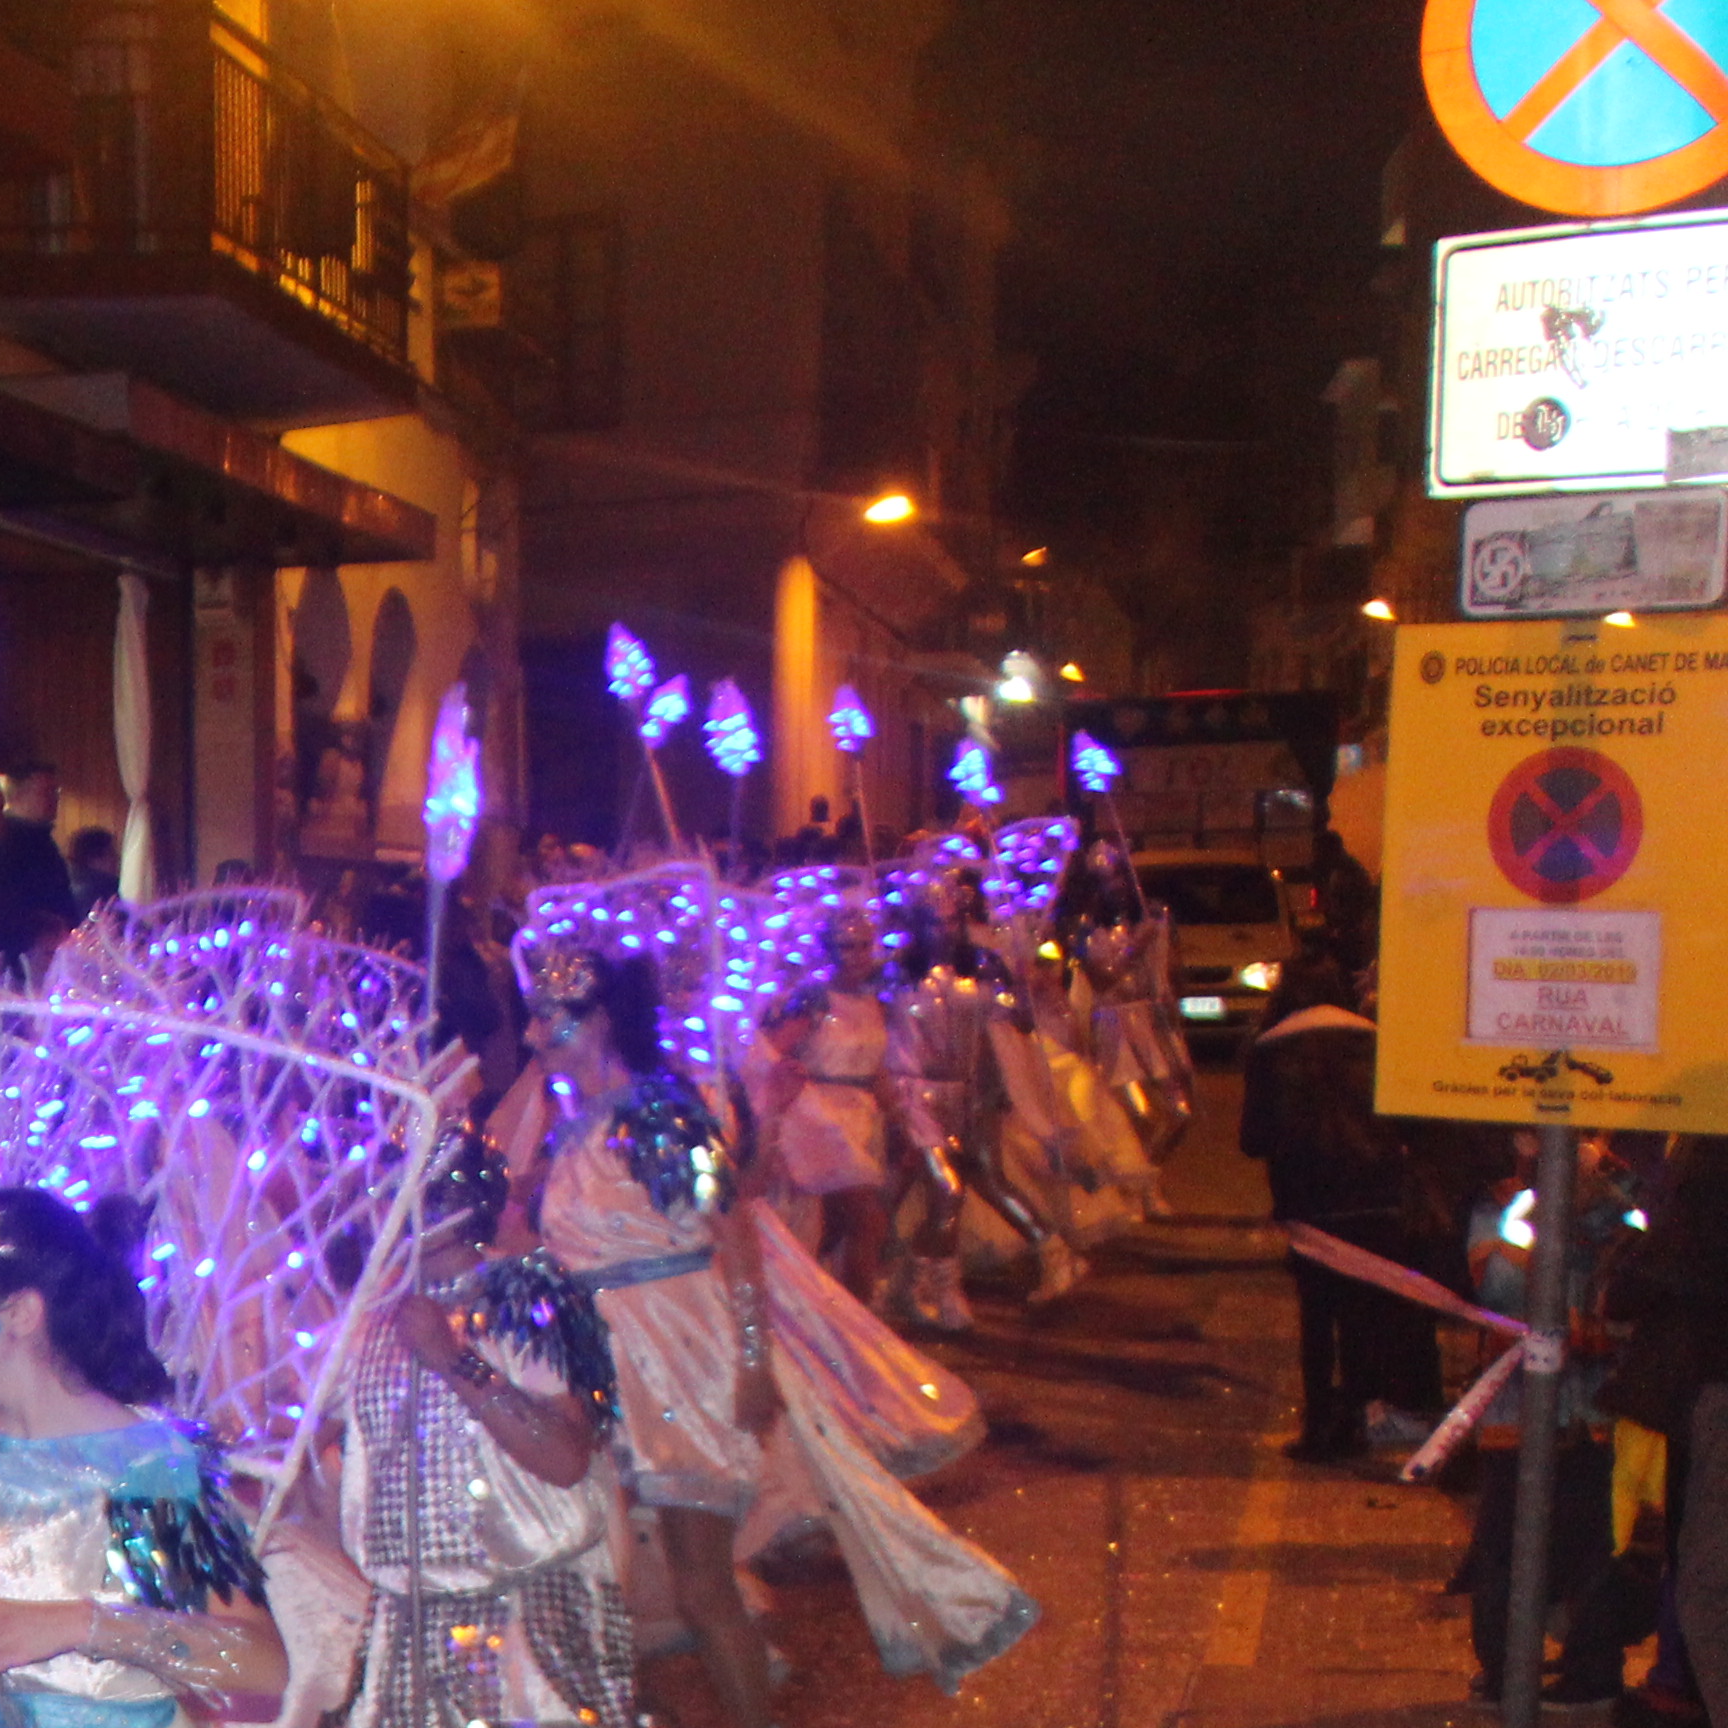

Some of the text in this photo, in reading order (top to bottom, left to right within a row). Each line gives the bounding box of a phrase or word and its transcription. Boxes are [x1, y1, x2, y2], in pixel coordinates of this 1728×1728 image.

[1686, 263, 1728, 297] PE
[1455, 655, 1520, 676] POLICIA
[1525, 654, 1580, 675] LOCAL
[1610, 652, 1670, 673] CANET
[1674, 650, 1699, 672] DE
[1474, 681, 1677, 712] Senyalització
[1481, 711, 1665, 741] excepcional
[1538, 986, 1588, 1006] RUA
[1497, 1011, 1627, 1034] CARNAVAL
